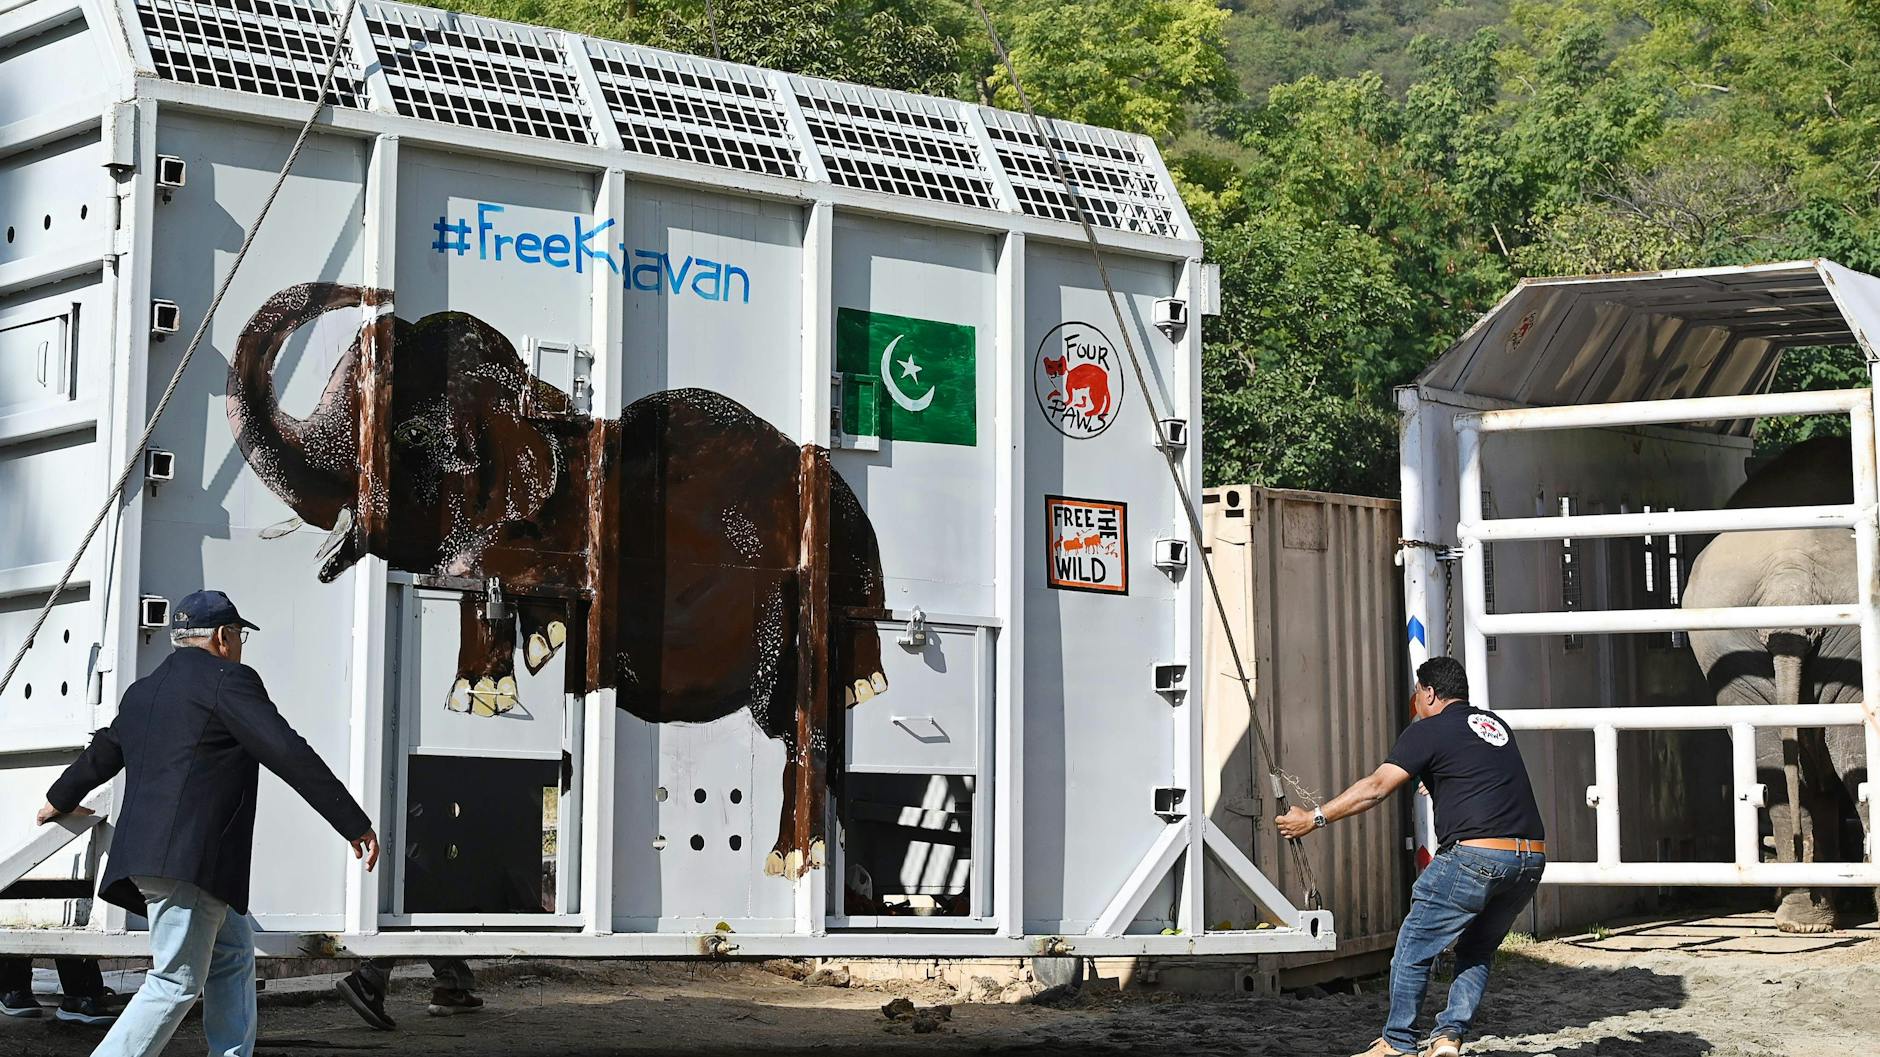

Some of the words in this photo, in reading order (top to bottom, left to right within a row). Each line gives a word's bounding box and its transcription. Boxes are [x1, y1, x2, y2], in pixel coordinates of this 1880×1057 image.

[1064, 334, 1110, 371] FOUR
[1047, 399, 1109, 432] PAWS
[1053, 506, 1094, 527] FREE
[1098, 508, 1118, 539] THE
[1055, 556, 1106, 583] WILD
